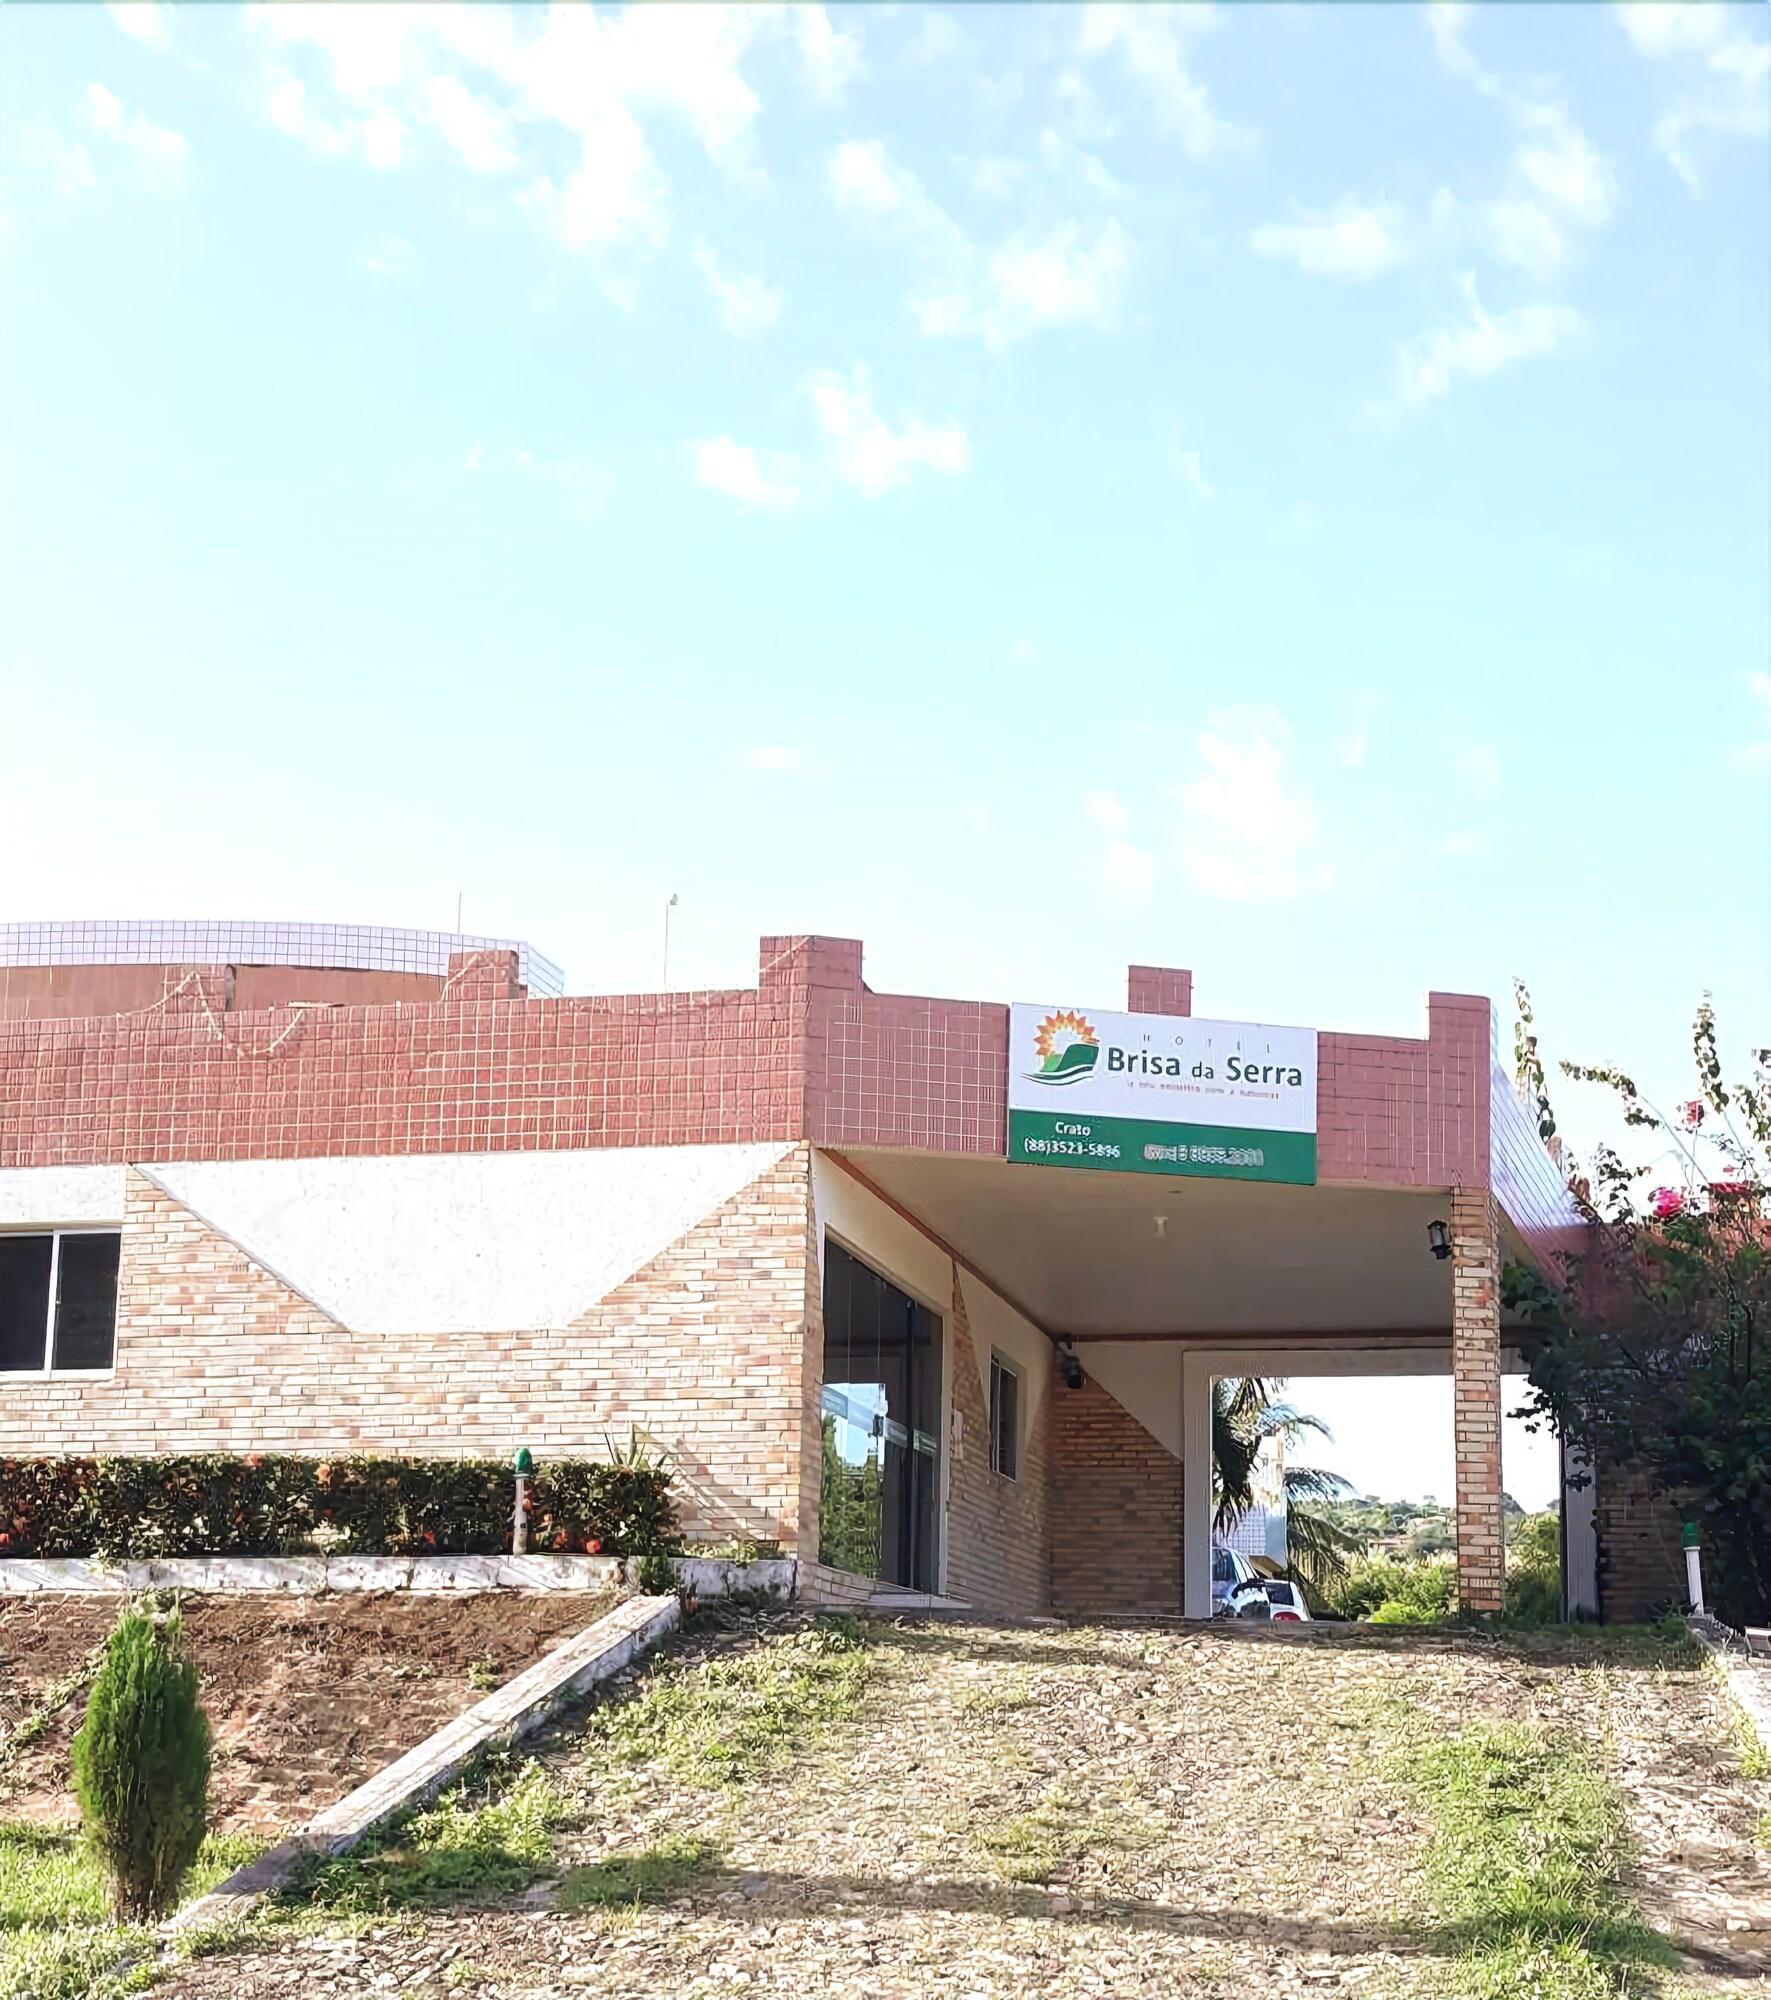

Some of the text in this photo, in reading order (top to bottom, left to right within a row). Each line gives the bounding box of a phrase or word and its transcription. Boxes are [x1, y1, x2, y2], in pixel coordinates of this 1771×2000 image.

[1107, 1047, 1302, 1087] Brisa da Serra
[1055, 1121, 1091, 1136] Crato
